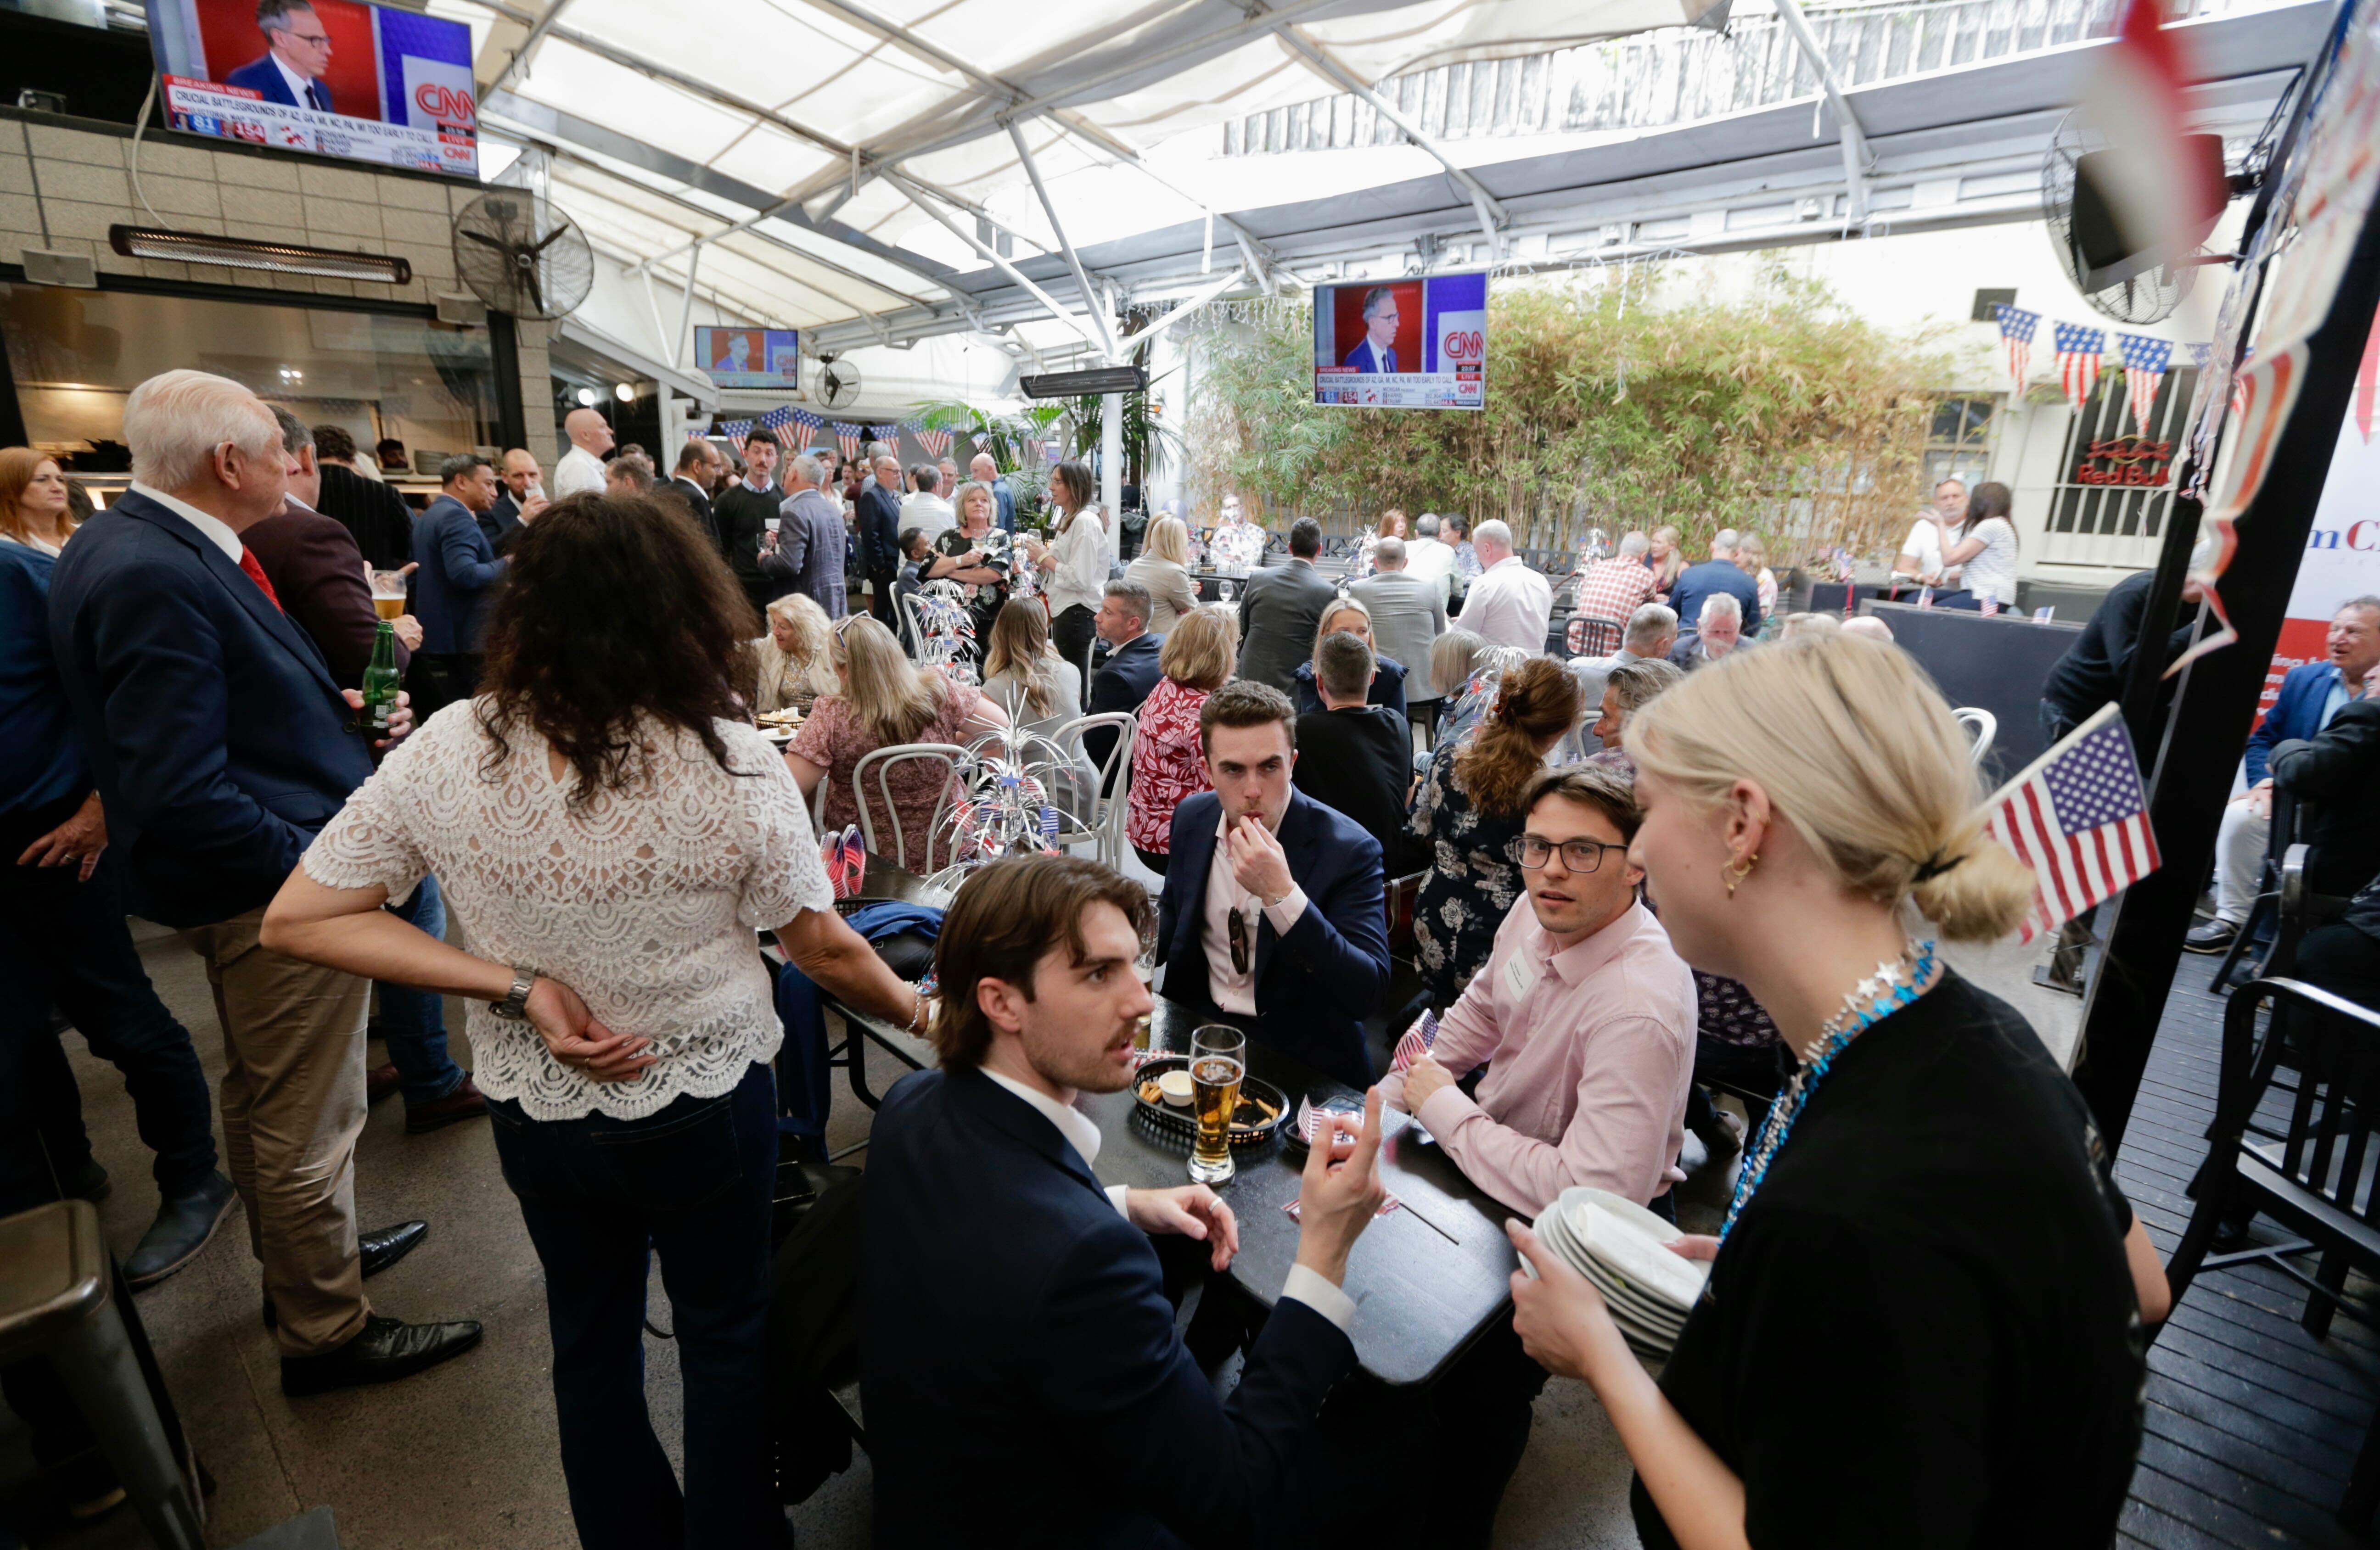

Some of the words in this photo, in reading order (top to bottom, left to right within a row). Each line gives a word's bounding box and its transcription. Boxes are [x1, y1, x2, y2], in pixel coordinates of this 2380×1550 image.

[173, 77, 225, 92] BREAKING
[225, 86, 257, 99] NEWS
[176, 90, 209, 105] CRUCIAL
[212, 96, 276, 117] BATTLEGROUNDS
[277, 107, 287, 118] OF
[416, 83, 475, 121] CNN
[193, 116, 216, 131] 81
[236, 122, 264, 137] 154
[443, 146, 471, 161] CNN
[1444, 330, 1483, 359] CNN
[1325, 392, 1335, 400] 81
[1344, 392, 1357, 401] 154
[1459, 383, 1477, 393] CNN
[2076, 464, 2125, 485] Red
[2124, 465, 2170, 486] Bull
